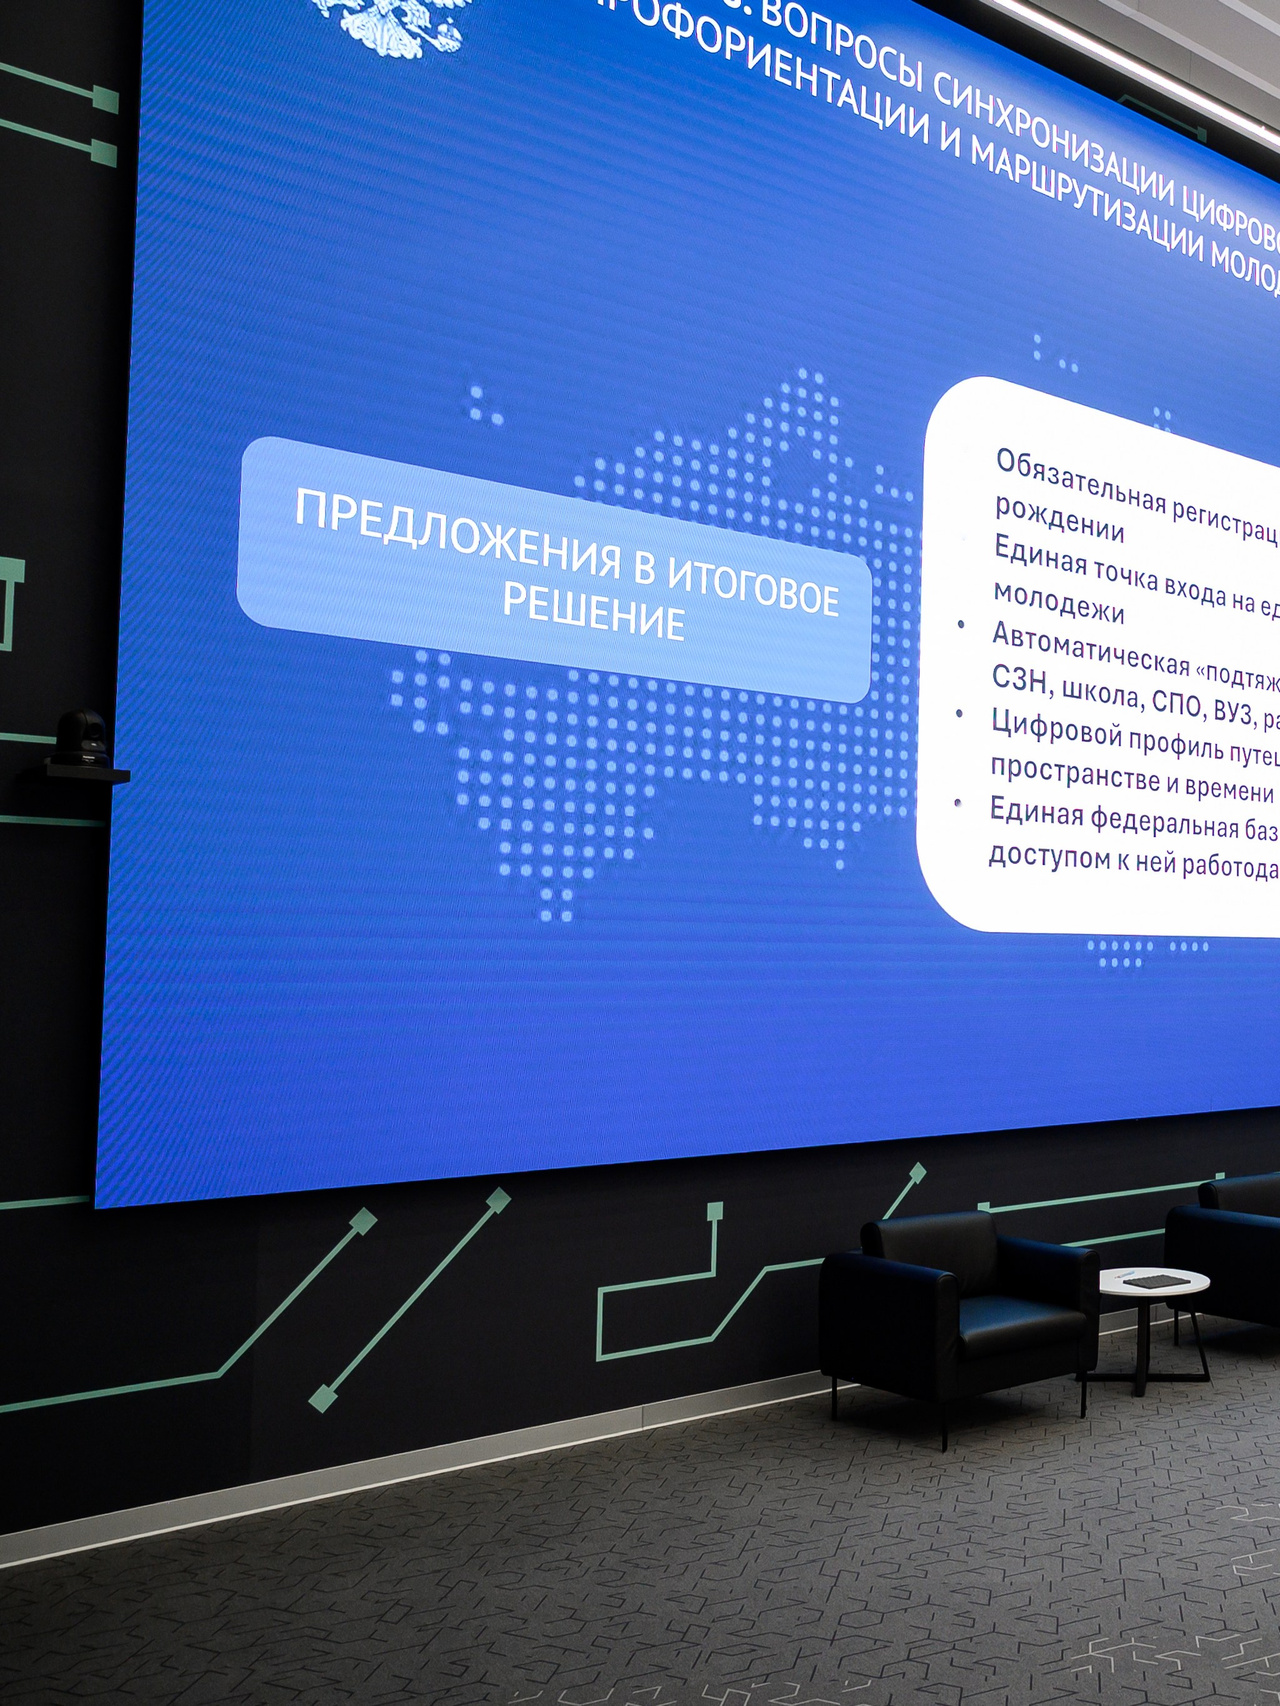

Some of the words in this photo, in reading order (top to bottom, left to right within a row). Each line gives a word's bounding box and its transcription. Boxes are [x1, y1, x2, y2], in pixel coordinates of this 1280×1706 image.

[597, 0, 929, 144] ОФОРИЕНТАЦИИ
[940, 120, 961, 158] И
[971, 134, 1204, 262] МАРШРУТИЗАЦИИ
[762, 0, 923, 93] ВОПРОСЫ
[933, 71, 1175, 207] СИНХРОНИЗАЦИИ
[996, 447, 1166, 515] Обязательная
[996, 495, 1124, 544] рождении
[296, 487, 621, 579] ПРЕДЛОЖЕНИЯ
[635, 550, 655, 585] В
[668, 557, 839, 617] ИТОГОВОЕ
[995, 532, 1087, 576] Единая
[1093, 560, 1158, 592] точка
[1165, 577, 1226, 609] входа
[1232, 593, 1255, 613] на
[504, 580, 686, 641] РЕШЕНИЕ
[994, 582, 1124, 625] молодежи
[992, 620, 1190, 677] Автоматическая
[992, 663, 1054, 700] СЗН,
[1062, 679, 1145, 714] школа,
[1152, 689, 1208, 723] СПО,
[1214, 698, 1258, 731] ВУЗ,
[992, 706, 1122, 747] Цифровой
[1129, 731, 1224, 761] профиль
[991, 756, 1161, 792] пространстве
[1167, 776, 1179, 794] и
[1185, 778, 1274, 804] времени
[990, 794, 1084, 827] Единая
[1090, 804, 1239, 839] федеральная
[988, 844, 1111, 873] доступом
[1118, 853, 1130, 871] к
[1136, 854, 1176, 874] ней
